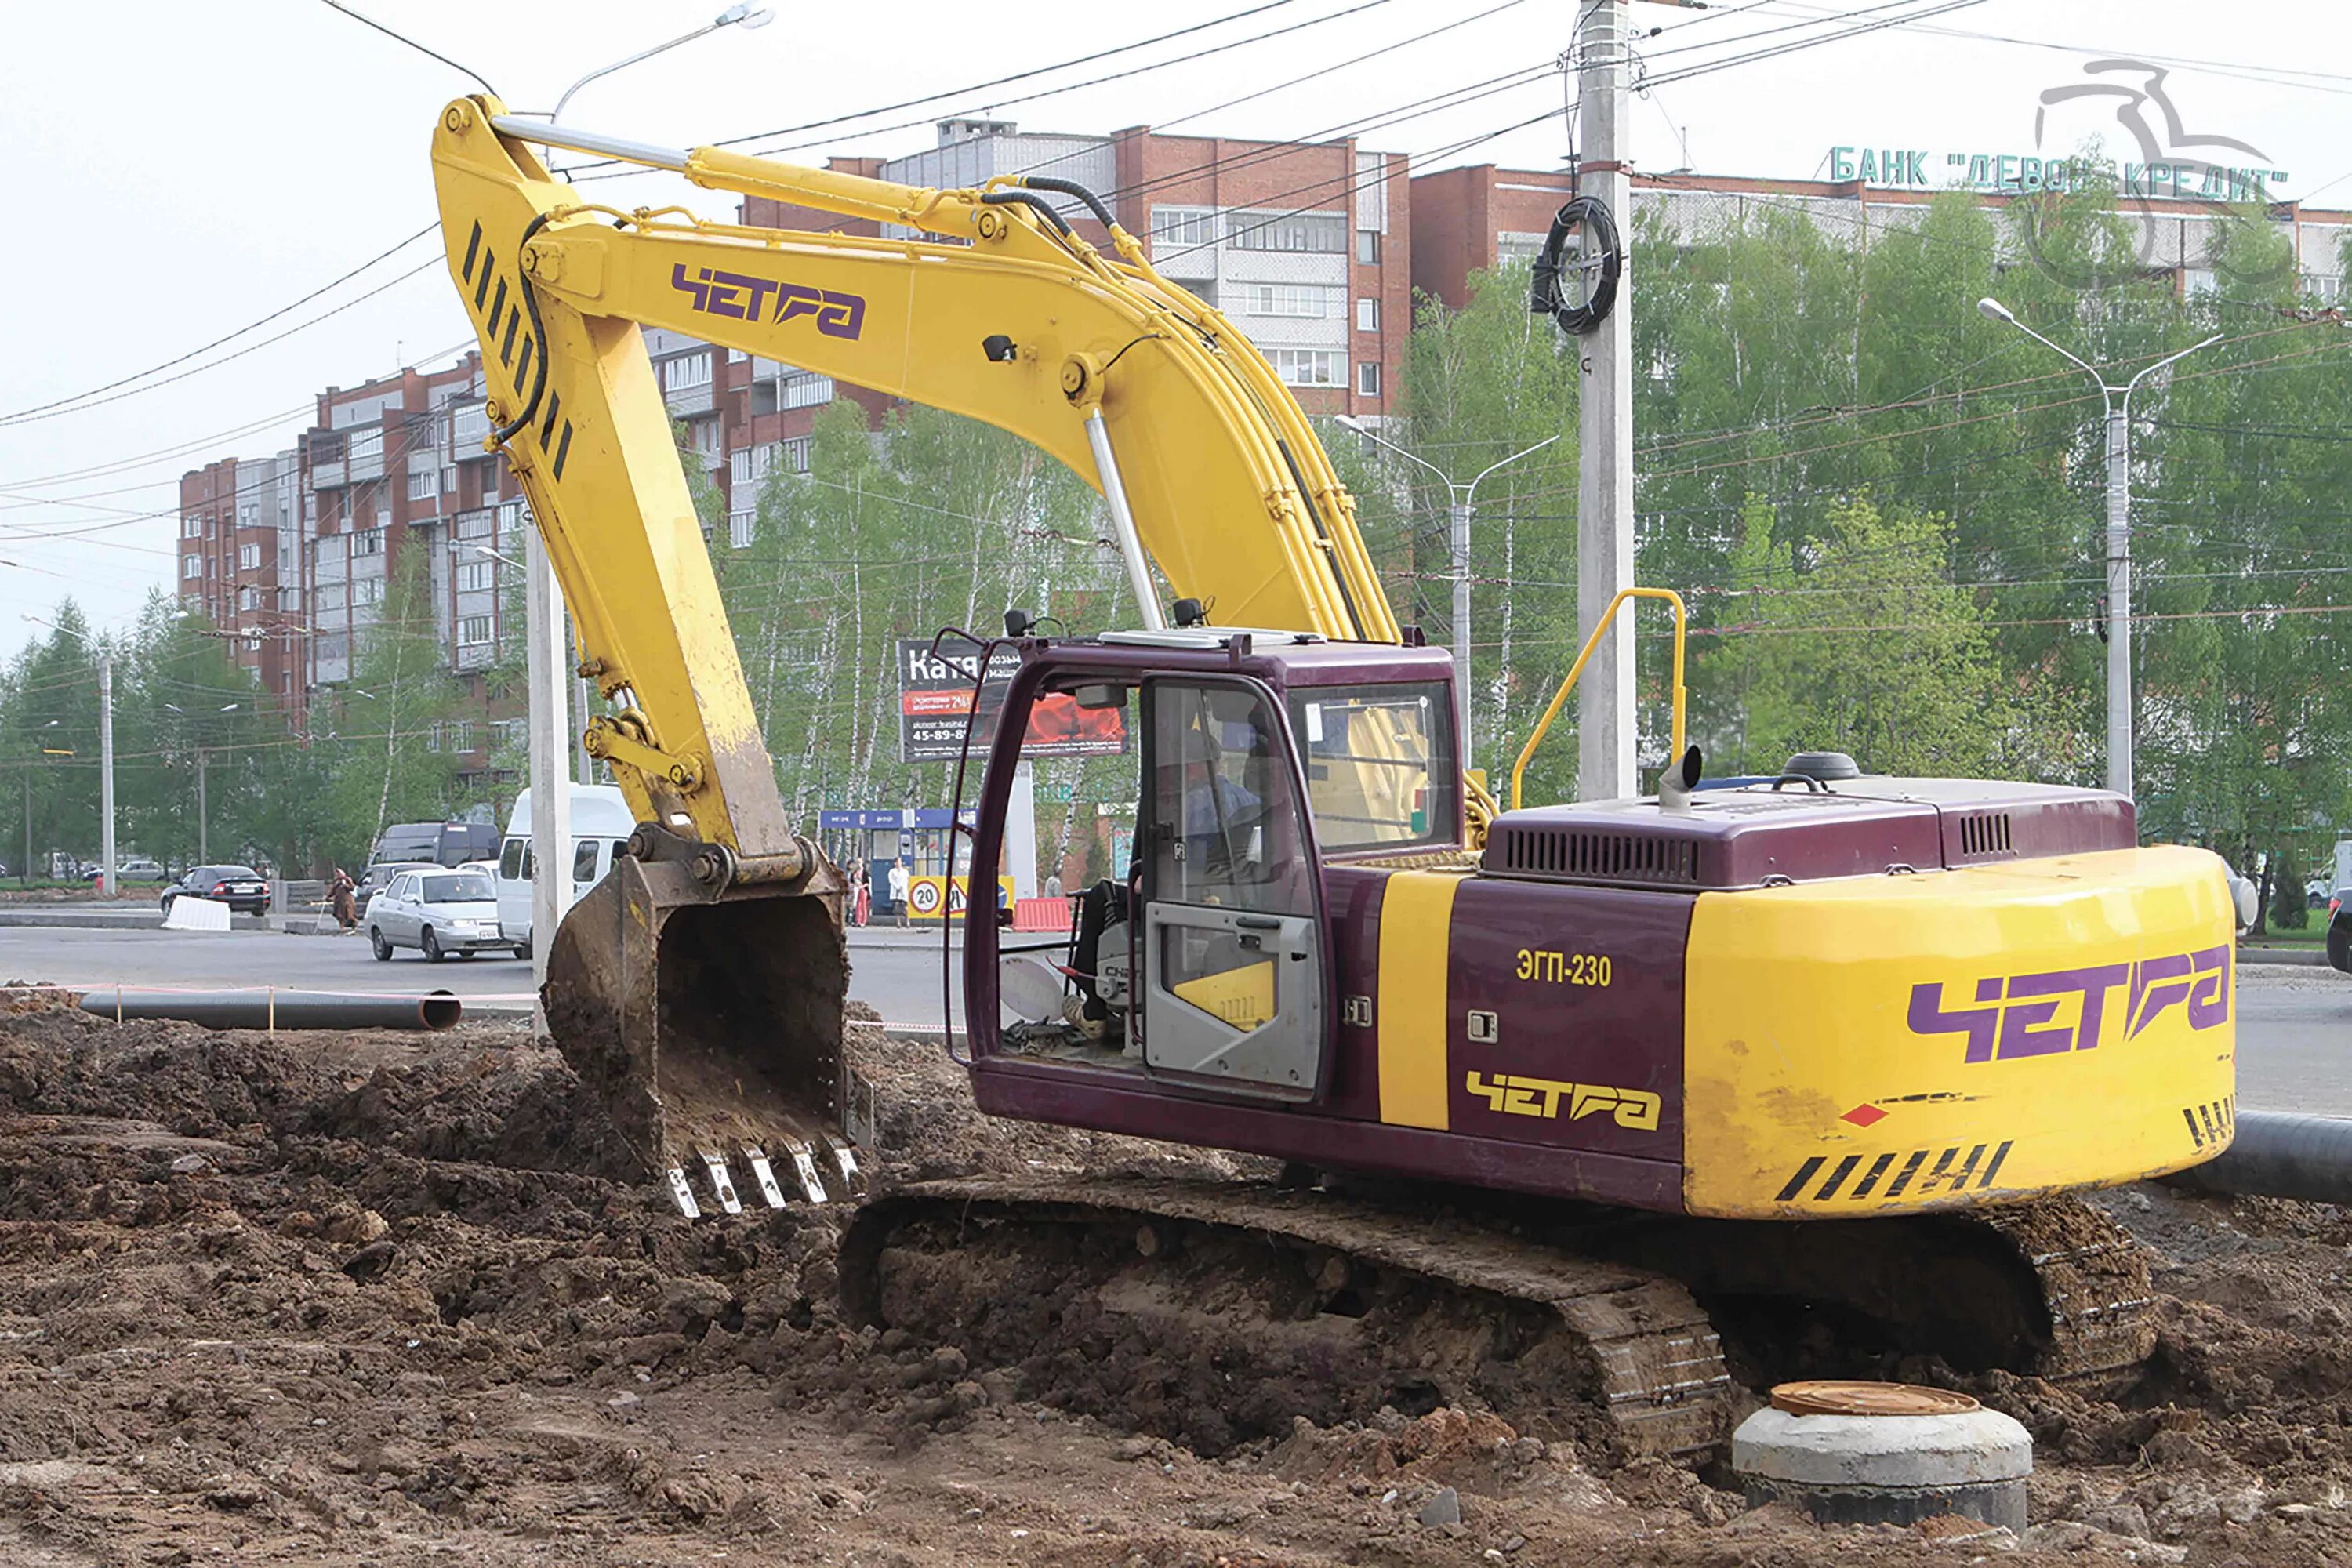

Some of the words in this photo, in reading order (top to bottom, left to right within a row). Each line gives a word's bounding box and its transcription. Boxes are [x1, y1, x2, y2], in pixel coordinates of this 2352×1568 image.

[1831, 147, 1929, 185] БАНК
[917, 889, 933, 904] 20
[1516, 949, 1612, 987] ЭГП-230
